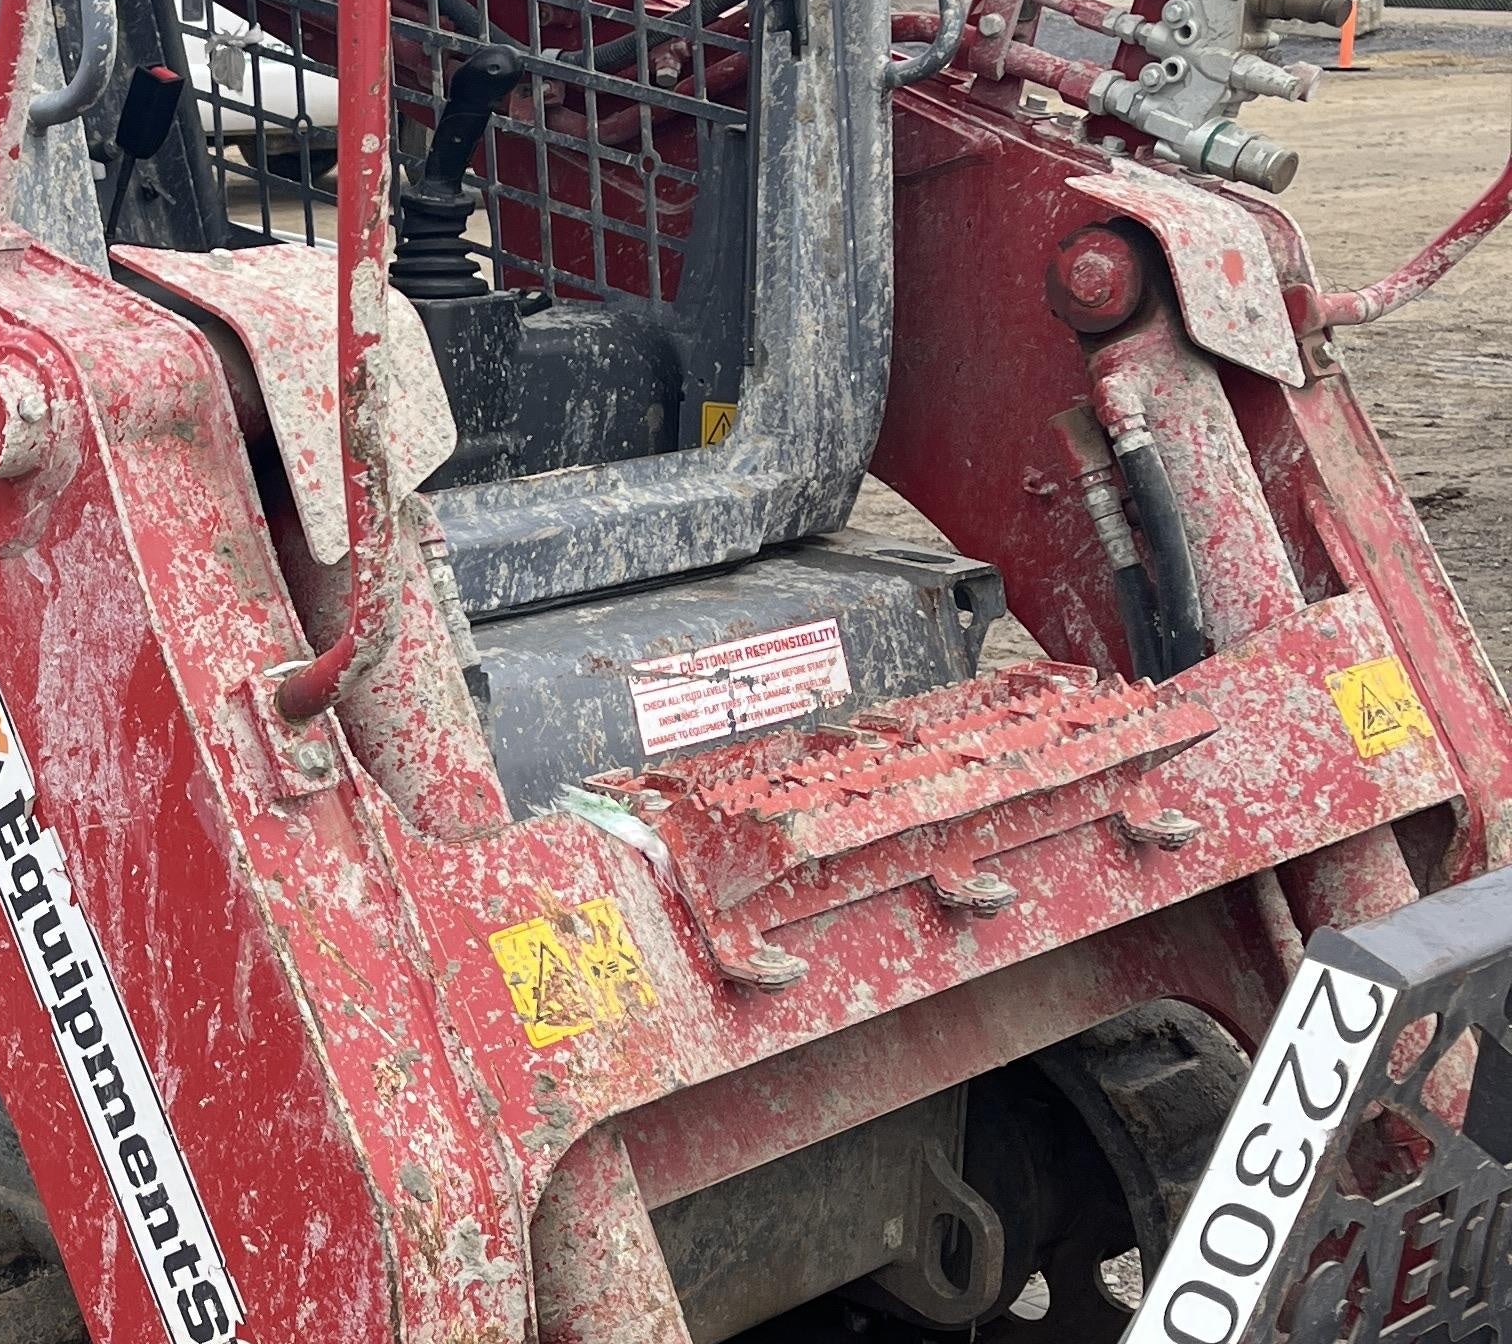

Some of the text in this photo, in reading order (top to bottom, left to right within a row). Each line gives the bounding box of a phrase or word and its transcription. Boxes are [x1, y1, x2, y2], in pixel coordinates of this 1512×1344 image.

[679, 648, 744, 676] CUSTOMER
[744, 626, 837, 659] RESPONSIBILITY
[643, 699, 667, 713] CHECK
[702, 684, 727, 697] LEVELS
[703, 703, 720, 715] FLAT
